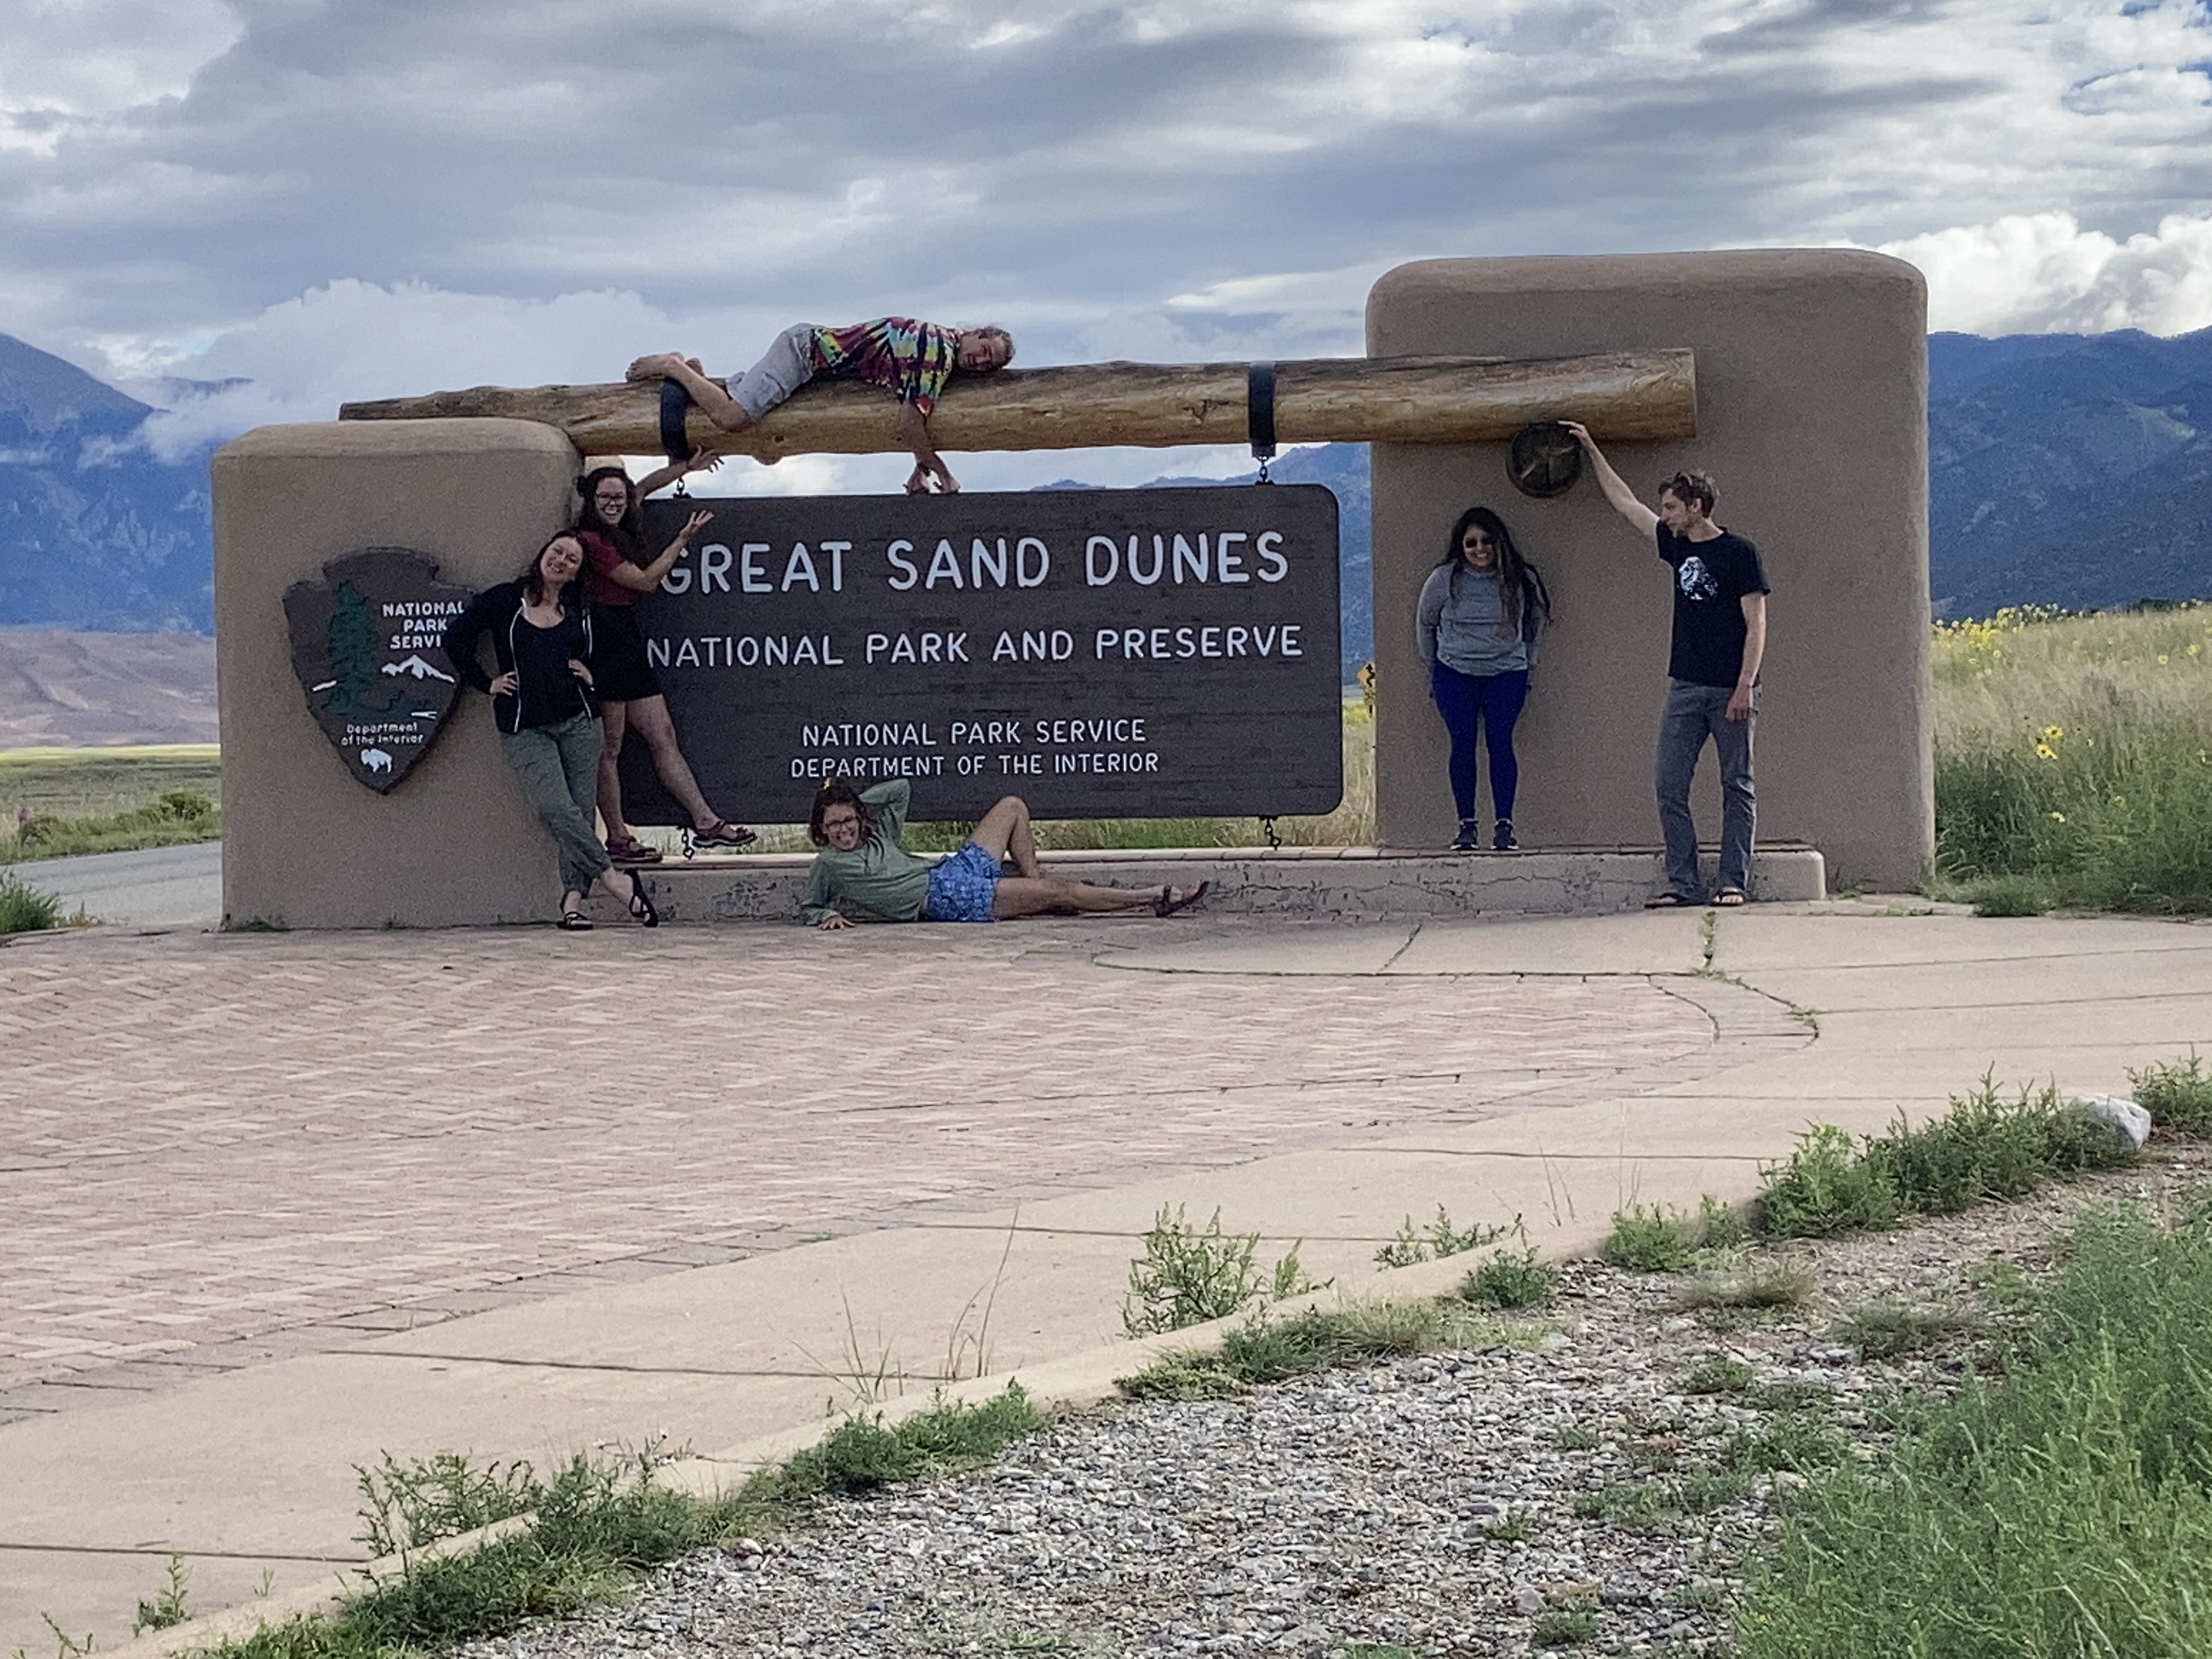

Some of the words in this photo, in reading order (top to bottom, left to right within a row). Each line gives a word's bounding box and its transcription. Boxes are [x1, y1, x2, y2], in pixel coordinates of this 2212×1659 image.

[661, 541, 852, 594] GREAT
[888, 538, 1049, 590] SAND
[1086, 532, 1288, 586] DUNES
[383, 601, 464, 617] NATIONAL
[404, 618, 447, 632] PARK
[390, 634, 441, 649] SERVI
[648, 635, 844, 667] NATIONAL
[867, 633, 969, 664] PARK
[992, 630, 1073, 661] AND
[1097, 625, 1302, 659] PRESERVE
[347, 721, 417, 735] Department
[803, 723, 936, 747] NATIONAL
[952, 721, 1021, 744] PARK
[1036, 719, 1146, 743] SERVICE
[342, 735, 353, 746] of
[356, 736, 374, 745] the
[792, 756, 945, 777] DEPARTMENT
[957, 755, 986, 775] OF
[998, 754, 1042, 774] THE
[1055, 753, 1158, 773] INTERIOR
